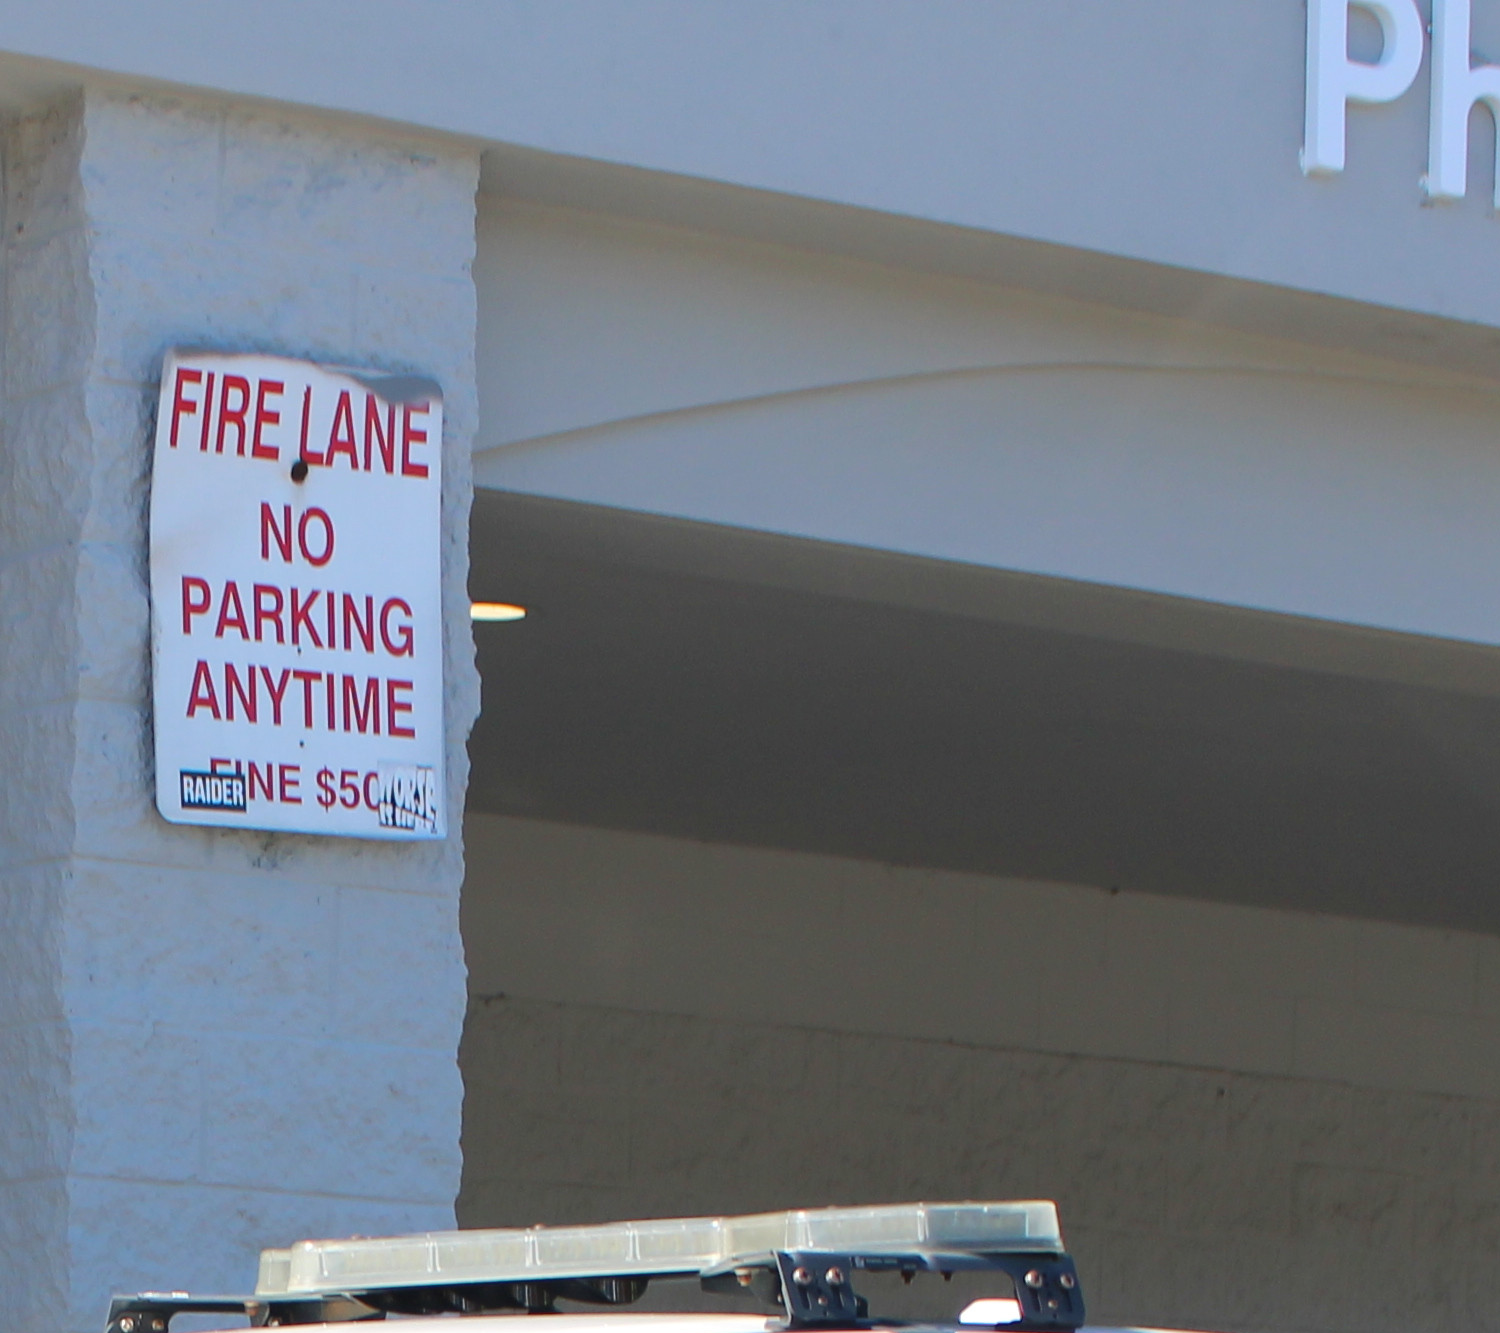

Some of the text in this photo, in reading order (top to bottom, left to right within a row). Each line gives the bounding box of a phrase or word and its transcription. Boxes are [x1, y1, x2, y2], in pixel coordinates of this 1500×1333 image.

[168, 366, 431, 479] FIRE LANE
[259, 501, 336, 568] NO
[180, 574, 416, 659] PARKING
[185, 659, 416, 740] ANYTIME
[181, 774, 245, 808] RAIDER
